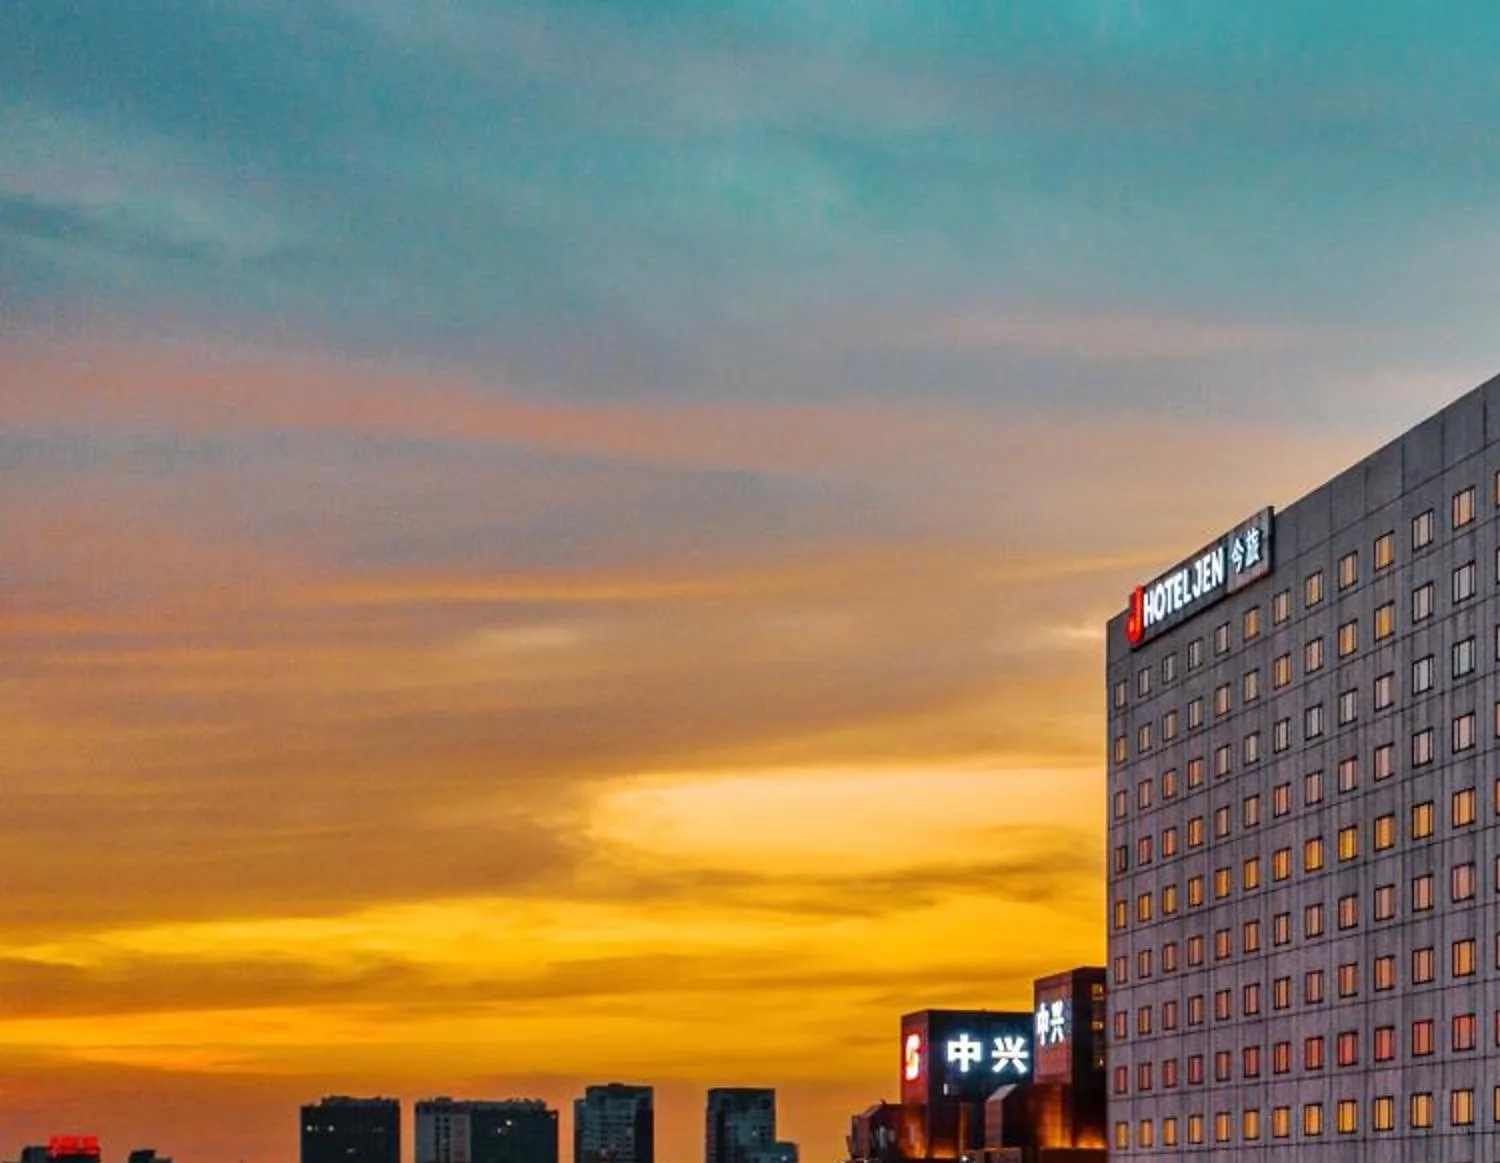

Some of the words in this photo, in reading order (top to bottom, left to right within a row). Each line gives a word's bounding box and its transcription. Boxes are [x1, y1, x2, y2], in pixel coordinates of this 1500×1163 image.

[1143, 568, 1192, 628] HOTEL
[1191, 546, 1225, 599] JEN
[1231, 526, 1261, 575] 今旅
[1036, 999, 1065, 1047] 中兴
[946, 1032, 1029, 1075] 中兴
